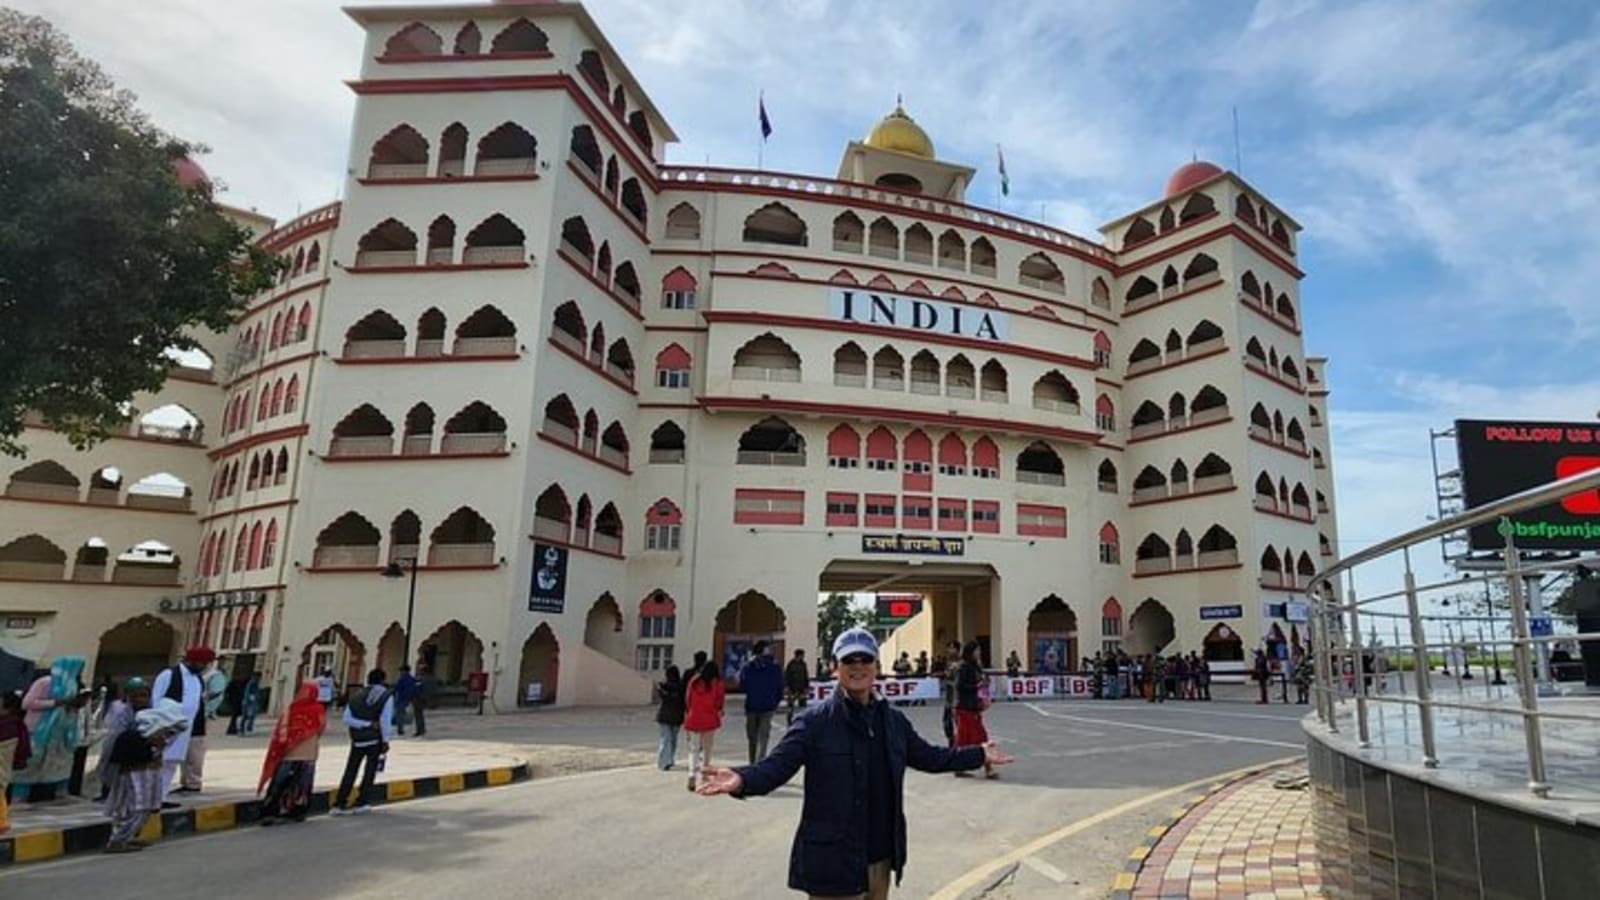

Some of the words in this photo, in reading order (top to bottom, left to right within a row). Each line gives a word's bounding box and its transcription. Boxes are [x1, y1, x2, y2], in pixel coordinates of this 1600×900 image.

[842, 291, 999, 340] INDIA
[1485, 426, 1562, 442] FOLLOW
[1566, 429, 1592, 443] US
[1012, 680, 1050, 694] BSF
